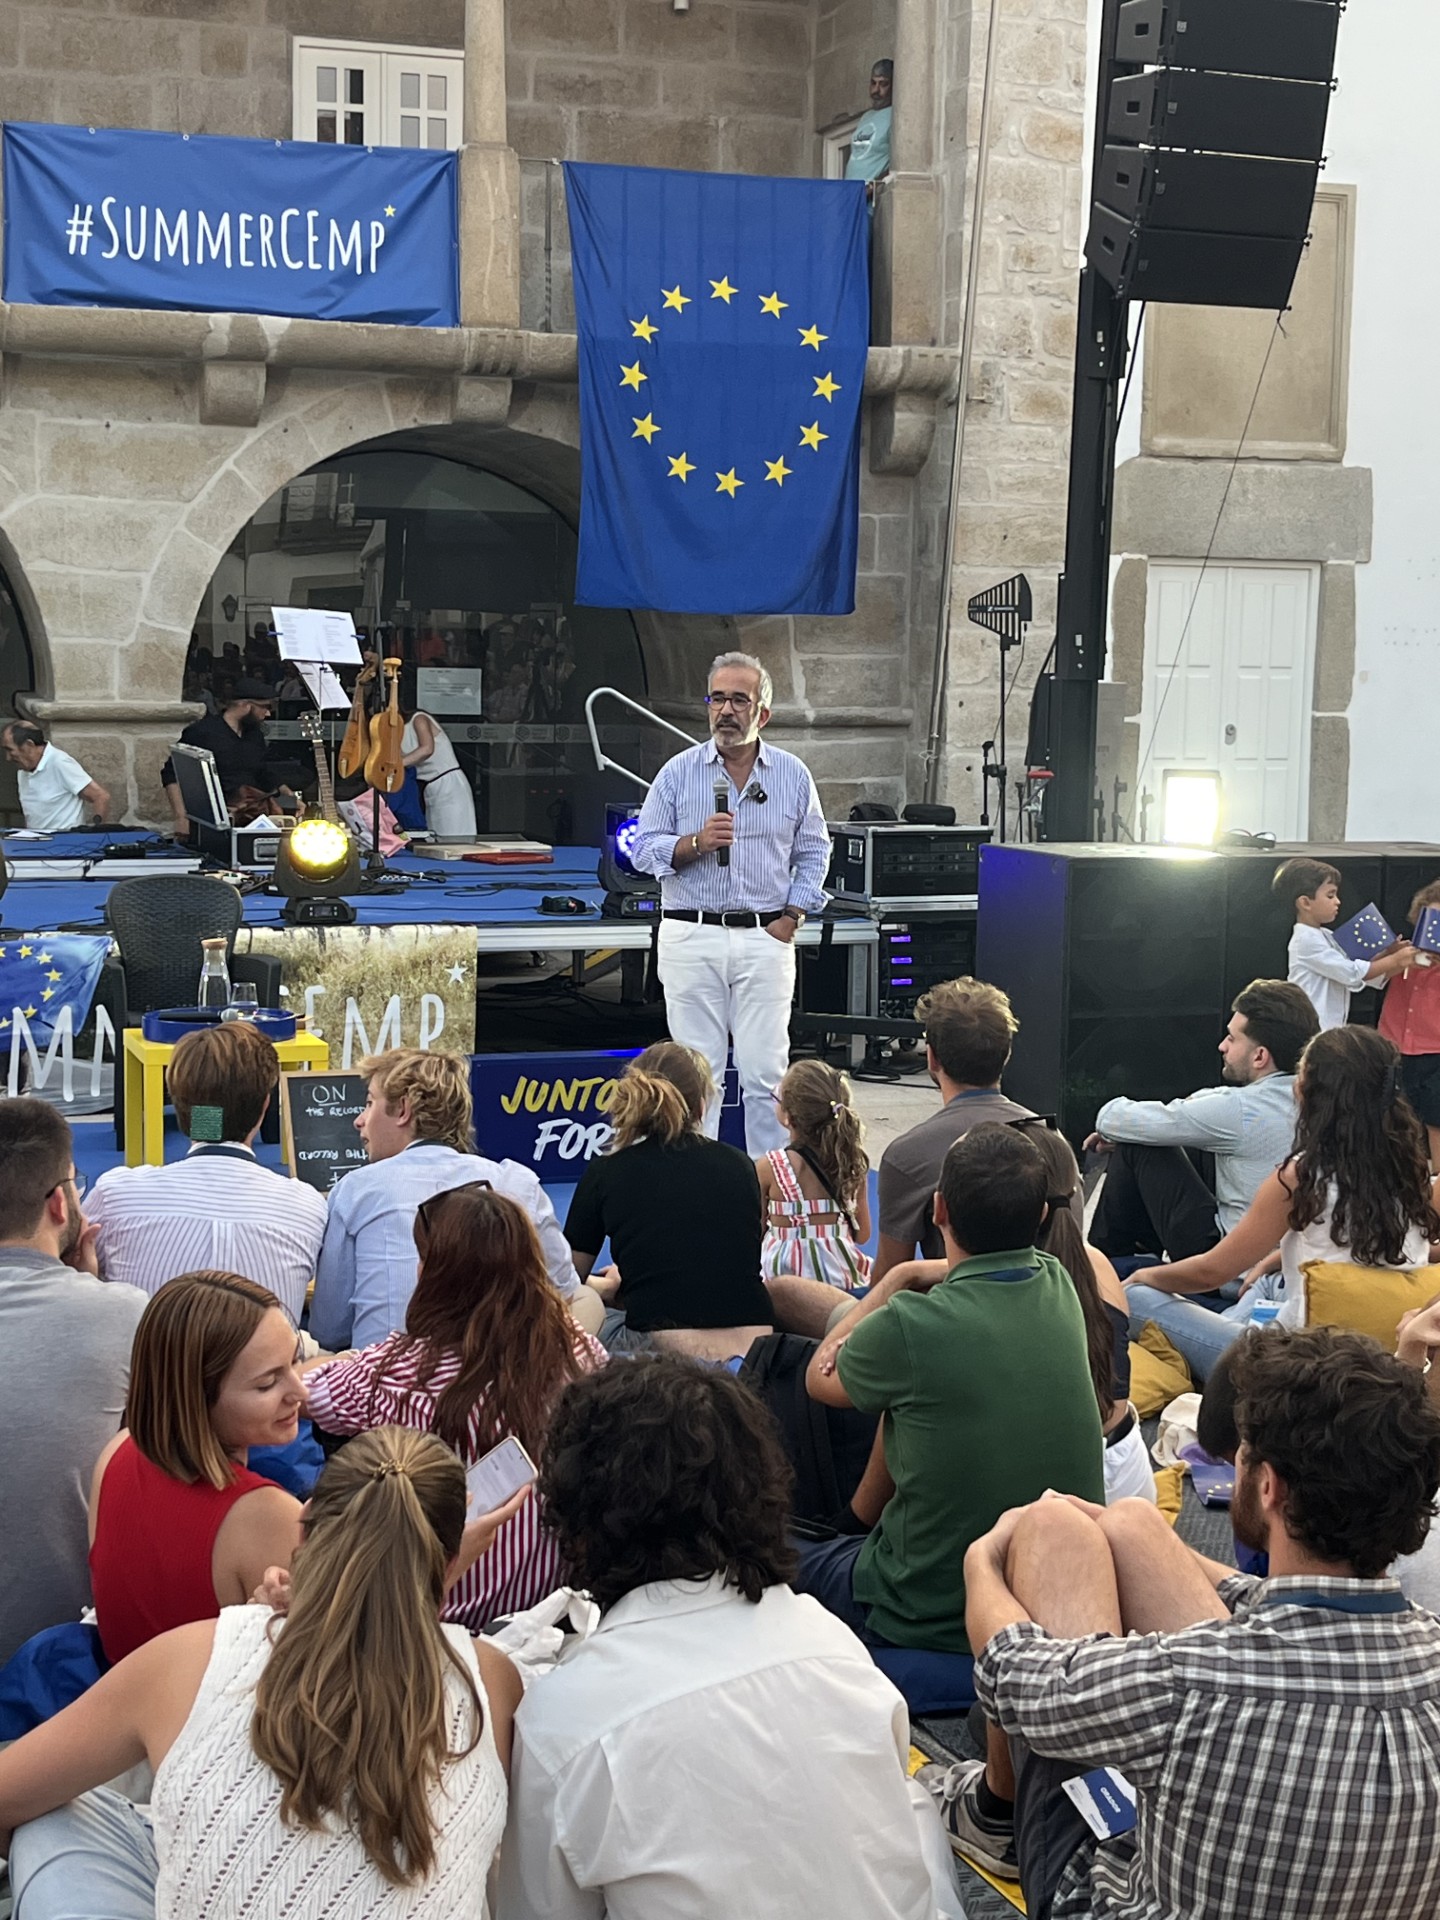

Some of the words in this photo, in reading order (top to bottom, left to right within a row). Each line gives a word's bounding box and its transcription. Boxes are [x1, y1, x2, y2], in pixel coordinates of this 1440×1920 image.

[312, 1083, 347, 1103] ON
[501, 1076, 621, 1114] JUNTO
[532, 1118, 621, 1162] FOR
